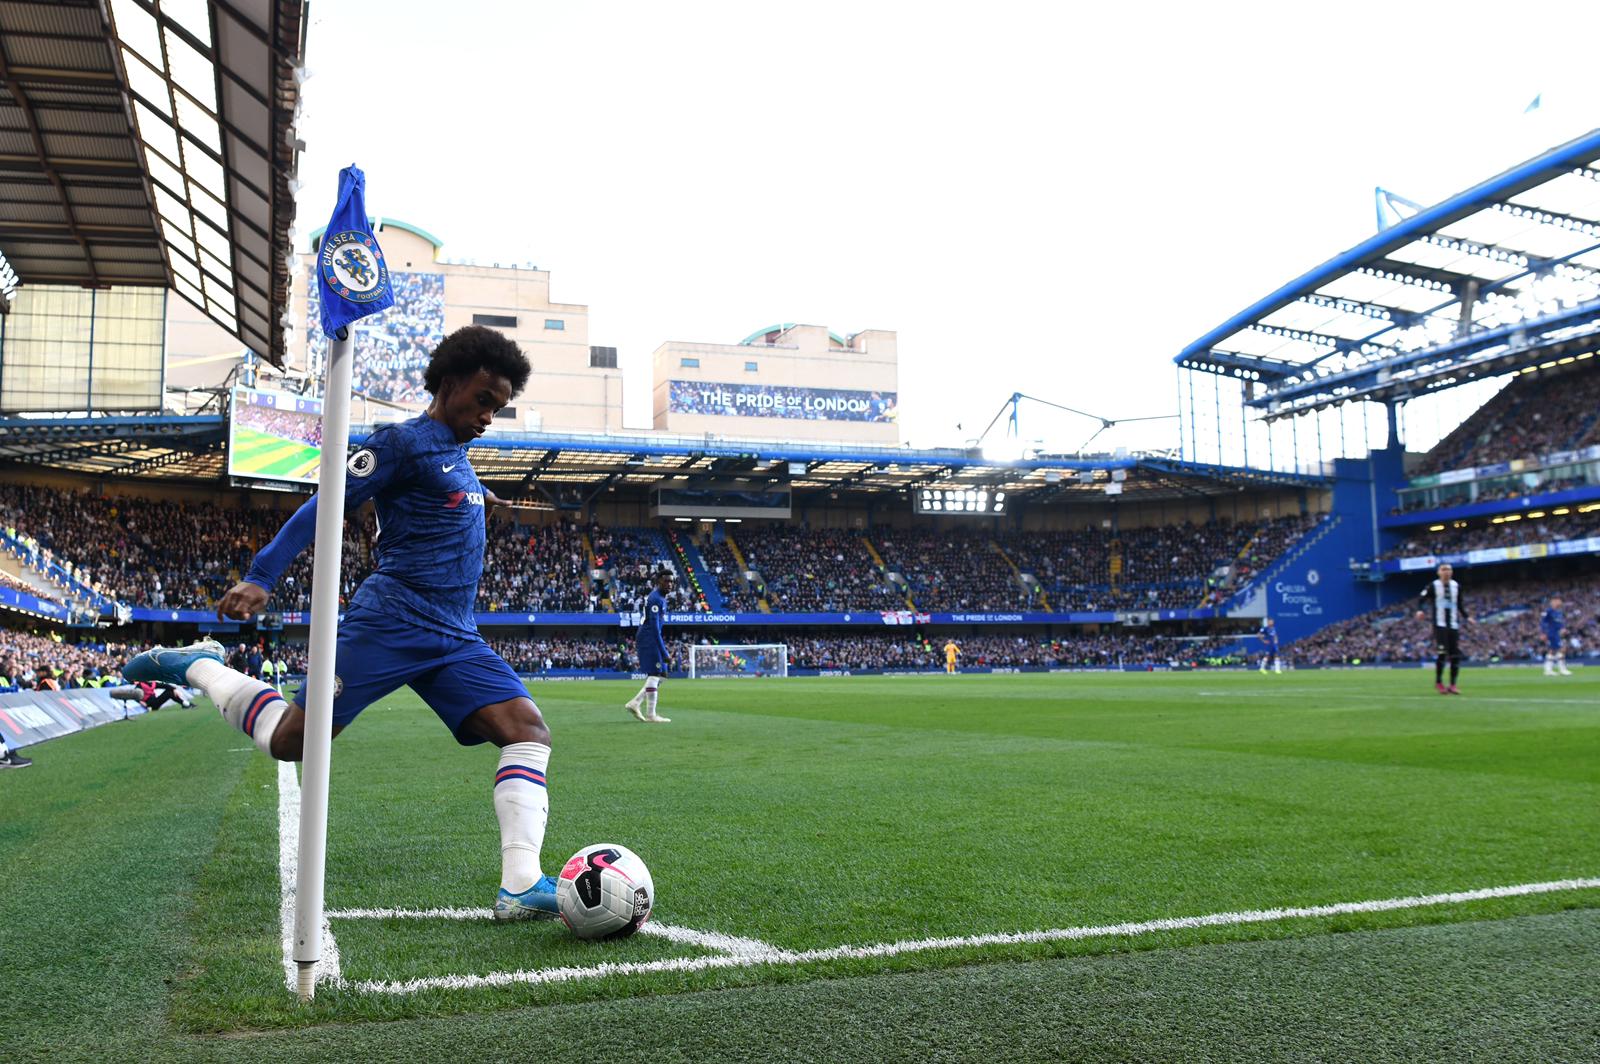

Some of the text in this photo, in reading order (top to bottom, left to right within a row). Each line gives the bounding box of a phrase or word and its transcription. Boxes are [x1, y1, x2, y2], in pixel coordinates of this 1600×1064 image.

[323, 233, 355, 266] CHELSEA
[357, 286, 384, 299] FOOTBALL
[701, 391, 870, 412] THE PRIDE OF LONDON
